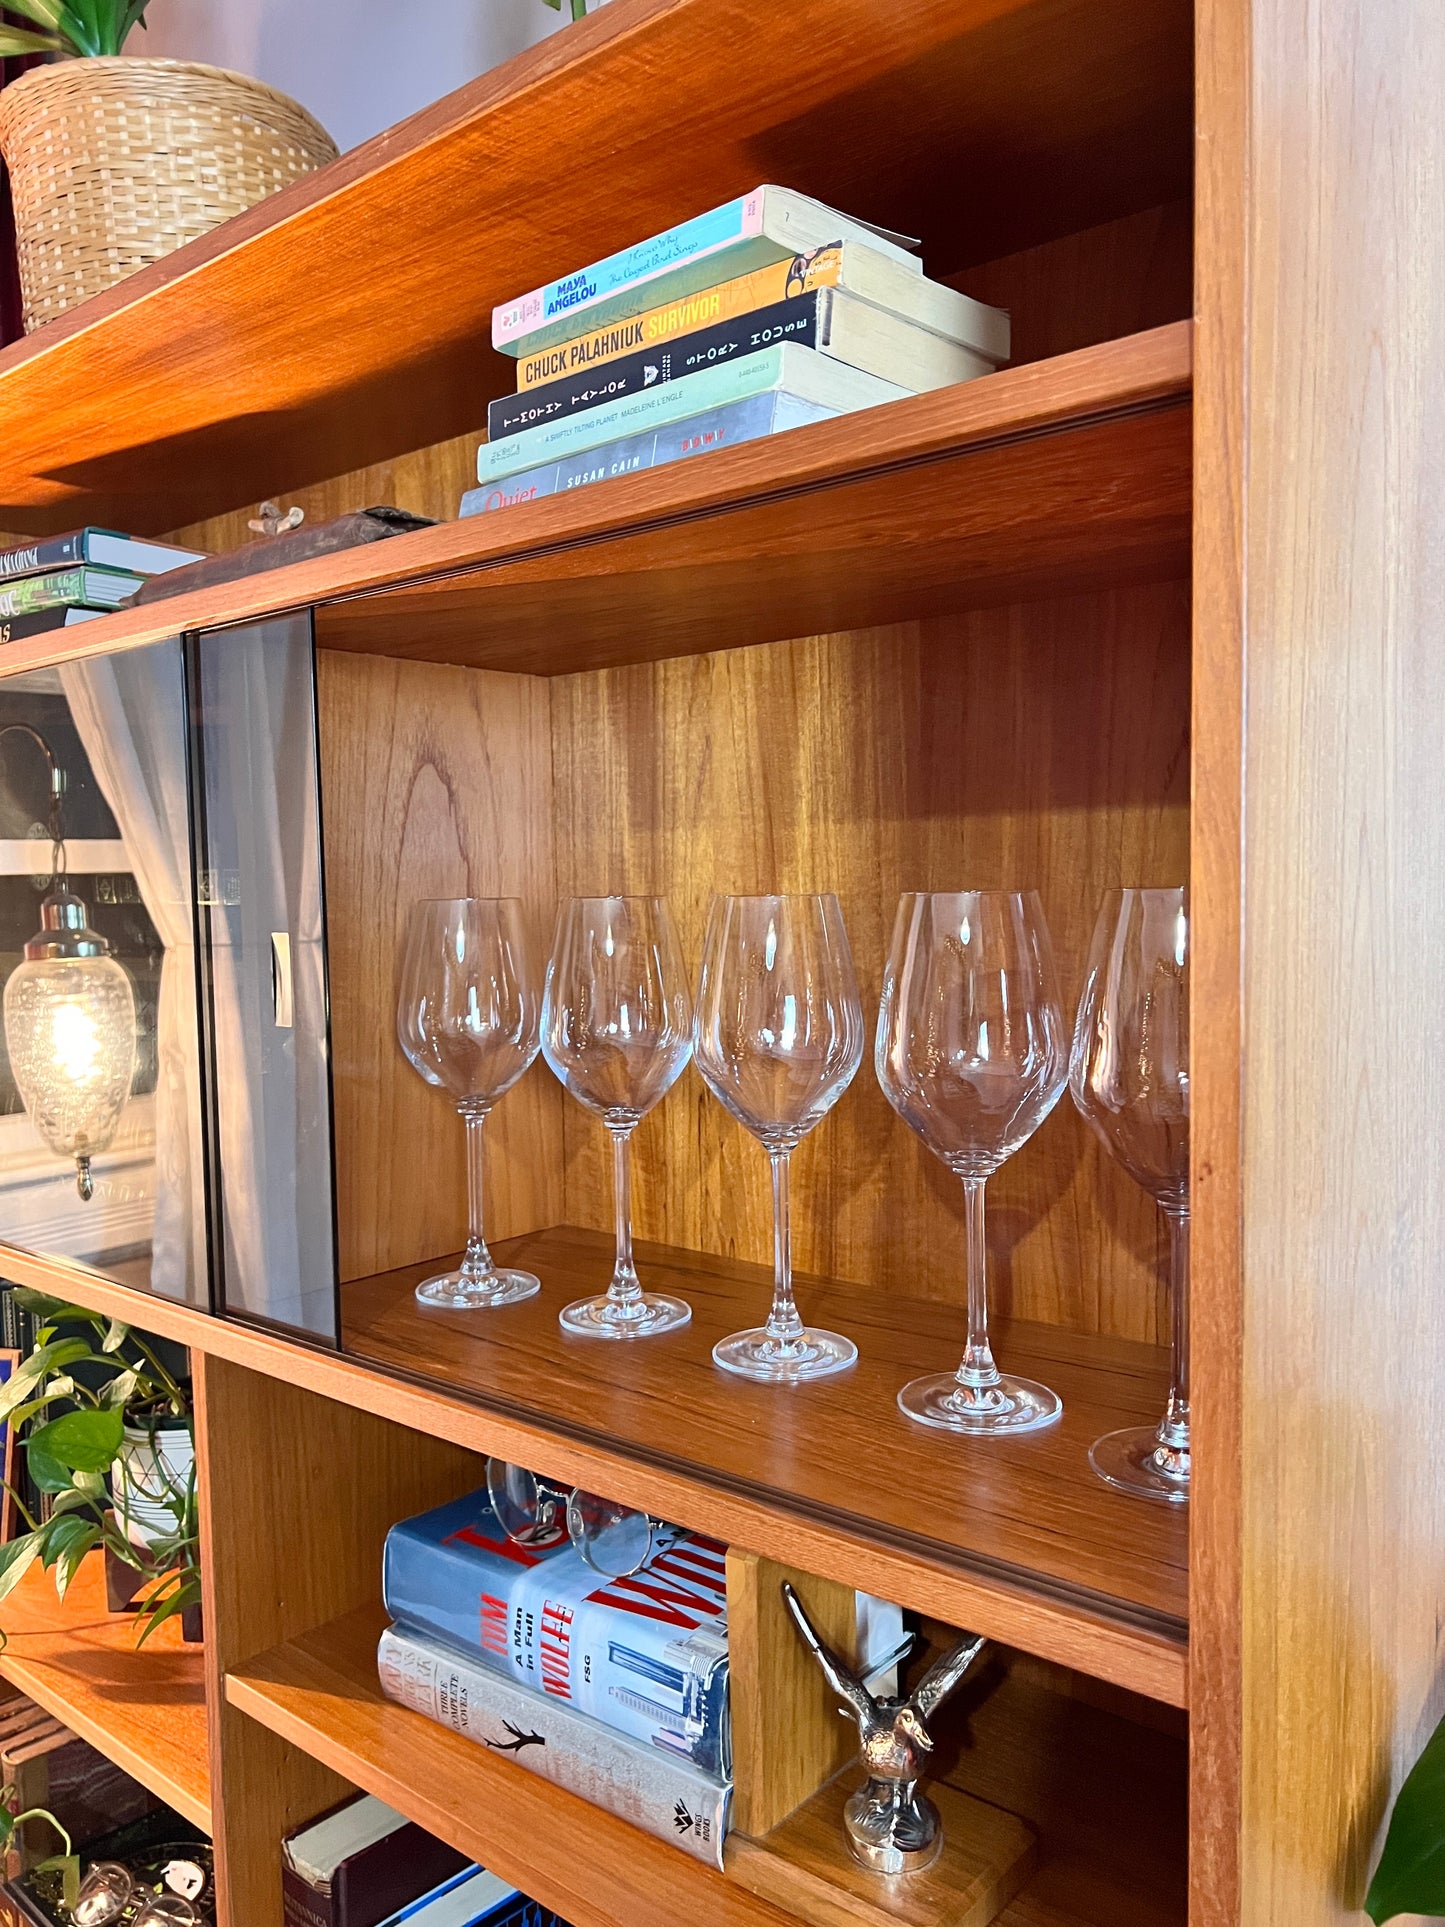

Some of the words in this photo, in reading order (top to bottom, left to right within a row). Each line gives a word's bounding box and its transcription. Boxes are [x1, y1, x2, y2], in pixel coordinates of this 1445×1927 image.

[656, 235, 678, 253] Why
[622, 257, 650, 279] Caged
[651, 249, 673, 267] Bird
[547, 283, 597, 315] ANGELOU
[557, 275, 587, 297] MAYA
[525, 344, 567, 383] CHUCK
[570, 320, 644, 372] PALAHNIUK
[649, 294, 720, 338] SURVIVOR
[686, 342, 738, 365] STORY
[751, 318, 807, 345] HOUSE
[504, 402, 562, 428] TIMOTHY
[572, 379, 626, 405] TAYLOR
[550, 428, 573, 442] SWIFTLY
[574, 421, 595, 435] TILTING
[596, 413, 618, 427] PLANET
[621, 398, 655, 418] MADELEINE
[656, 390, 684, 407] L'ENGLE
[485, 485, 537, 512] Quiet
[567, 469, 604, 488] SUSAN
[611, 456, 640, 475] CAIN
[481, 1591, 508, 1656] TOM
[514, 1607, 522, 1647] Man
[525, 1613, 533, 1647] Full
[515, 1654, 523, 1668] A
[526, 1654, 534, 1670] in
[540, 1599, 574, 1699] WOLFE
[440, 1680, 449, 1714] THREE
[450, 1673, 460, 1730] COMPLETE
[460, 1687, 470, 1729] NOVELS
[694, 1813, 703, 1837] WINGS
[703, 1818, 711, 1842] BOOKS
